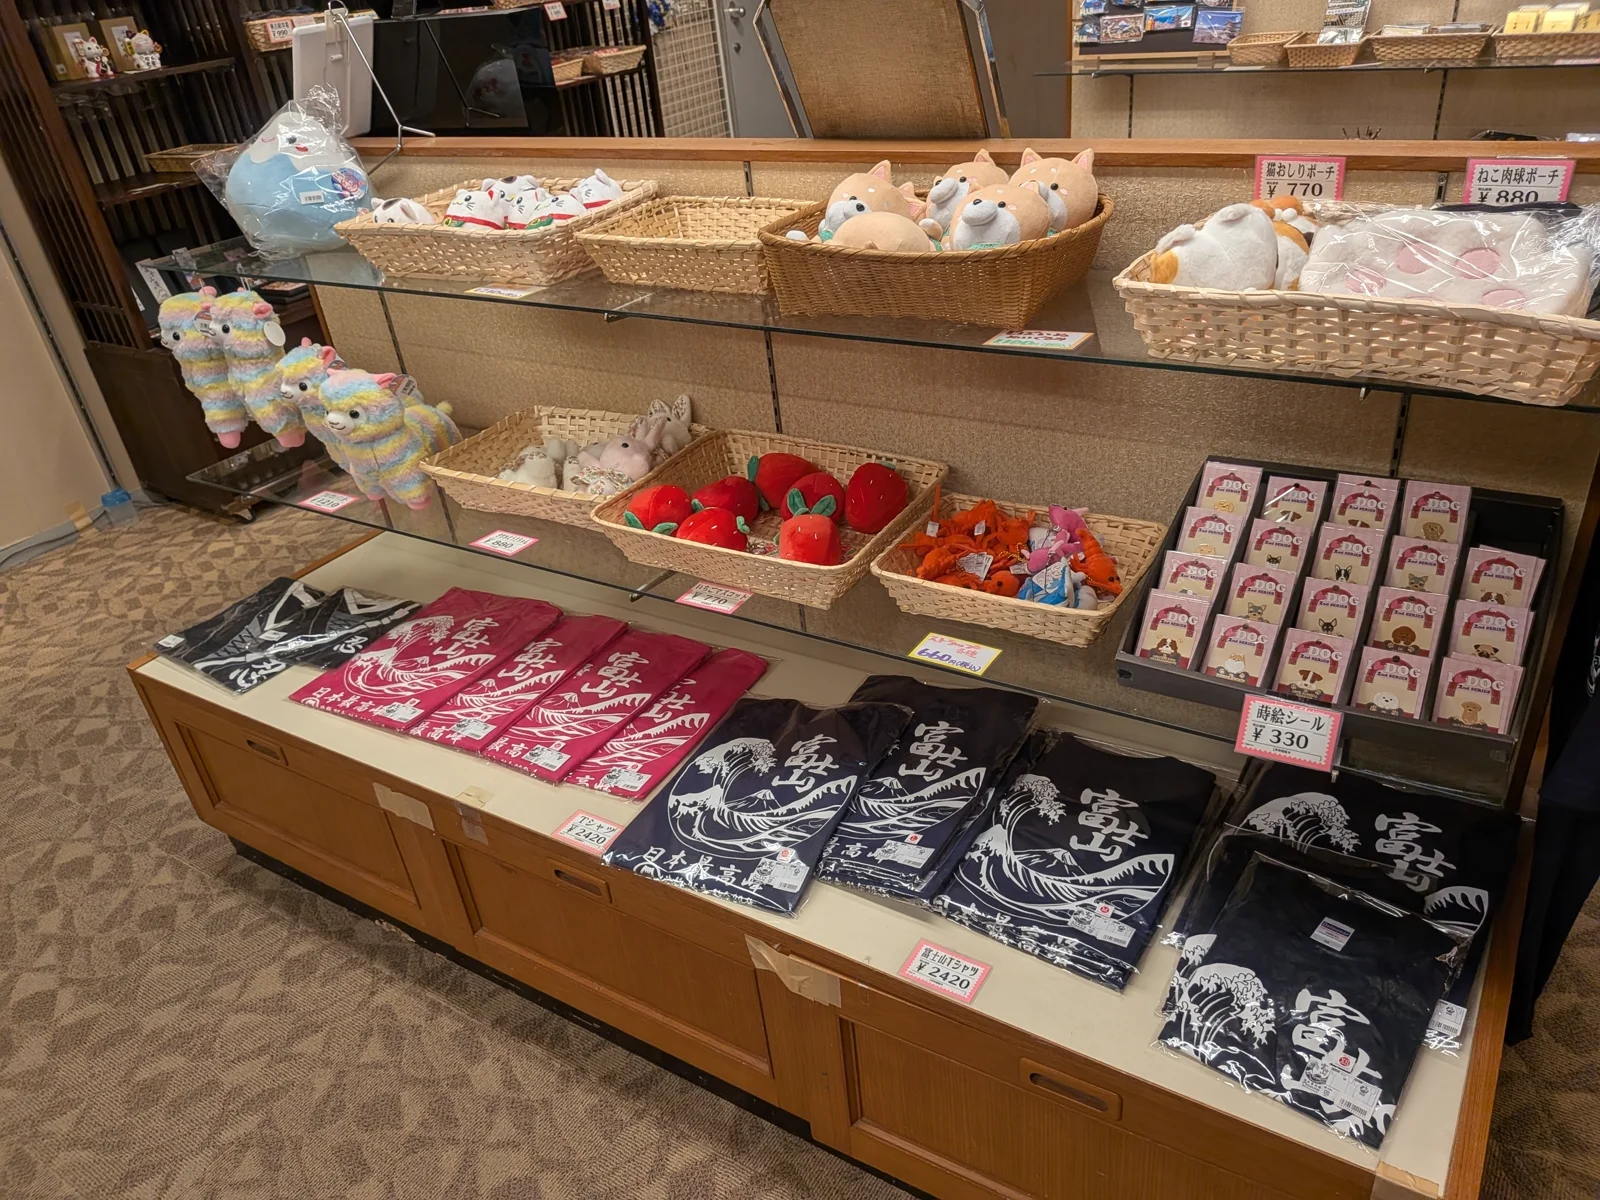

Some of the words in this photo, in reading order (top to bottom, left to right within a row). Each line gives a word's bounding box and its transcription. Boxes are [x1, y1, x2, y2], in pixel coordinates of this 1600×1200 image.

[1266, 162, 1335, 180] 猫おしりポーチ
[1477, 166, 1559, 186] ねこ肉球ポーチ
[1287, 182, 1323, 198] 770
[1495, 190, 1539, 202] 880
[1223, 480, 1251, 491] DOG
[1356, 497, 1388, 509] DOG
[1428, 498, 1460, 510] DOG
[1205, 521, 1234, 533] DOG
[492, 540, 514, 548] 880
[1272, 533, 1302, 545] DOG
[1341, 542, 1373, 554] DOG
[1415, 551, 1448, 563] DOG
[1491, 564, 1526, 577] DOG
[695, 584, 747, 600] いちごマスコット
[1255, 580, 1286, 592] DOG
[704, 594, 728, 604] 770
[1326, 593, 1359, 605] DOG
[1402, 602, 1437, 615] DOG
[1168, 611, 1199, 625] DOG
[1482, 615, 1518, 628] DOG
[1237, 629, 1268, 644] DOG
[1308, 646, 1343, 660] DOG
[1385, 663, 1421, 678] DOG
[1466, 675, 1505, 690] DOG
[1256, 704, 1326, 732] 蒔絵シール
[1269, 729, 1308, 750] 330
[578, 816, 618, 834] Tシャツ
[921, 947, 980, 976] 富士山Tシャツ
